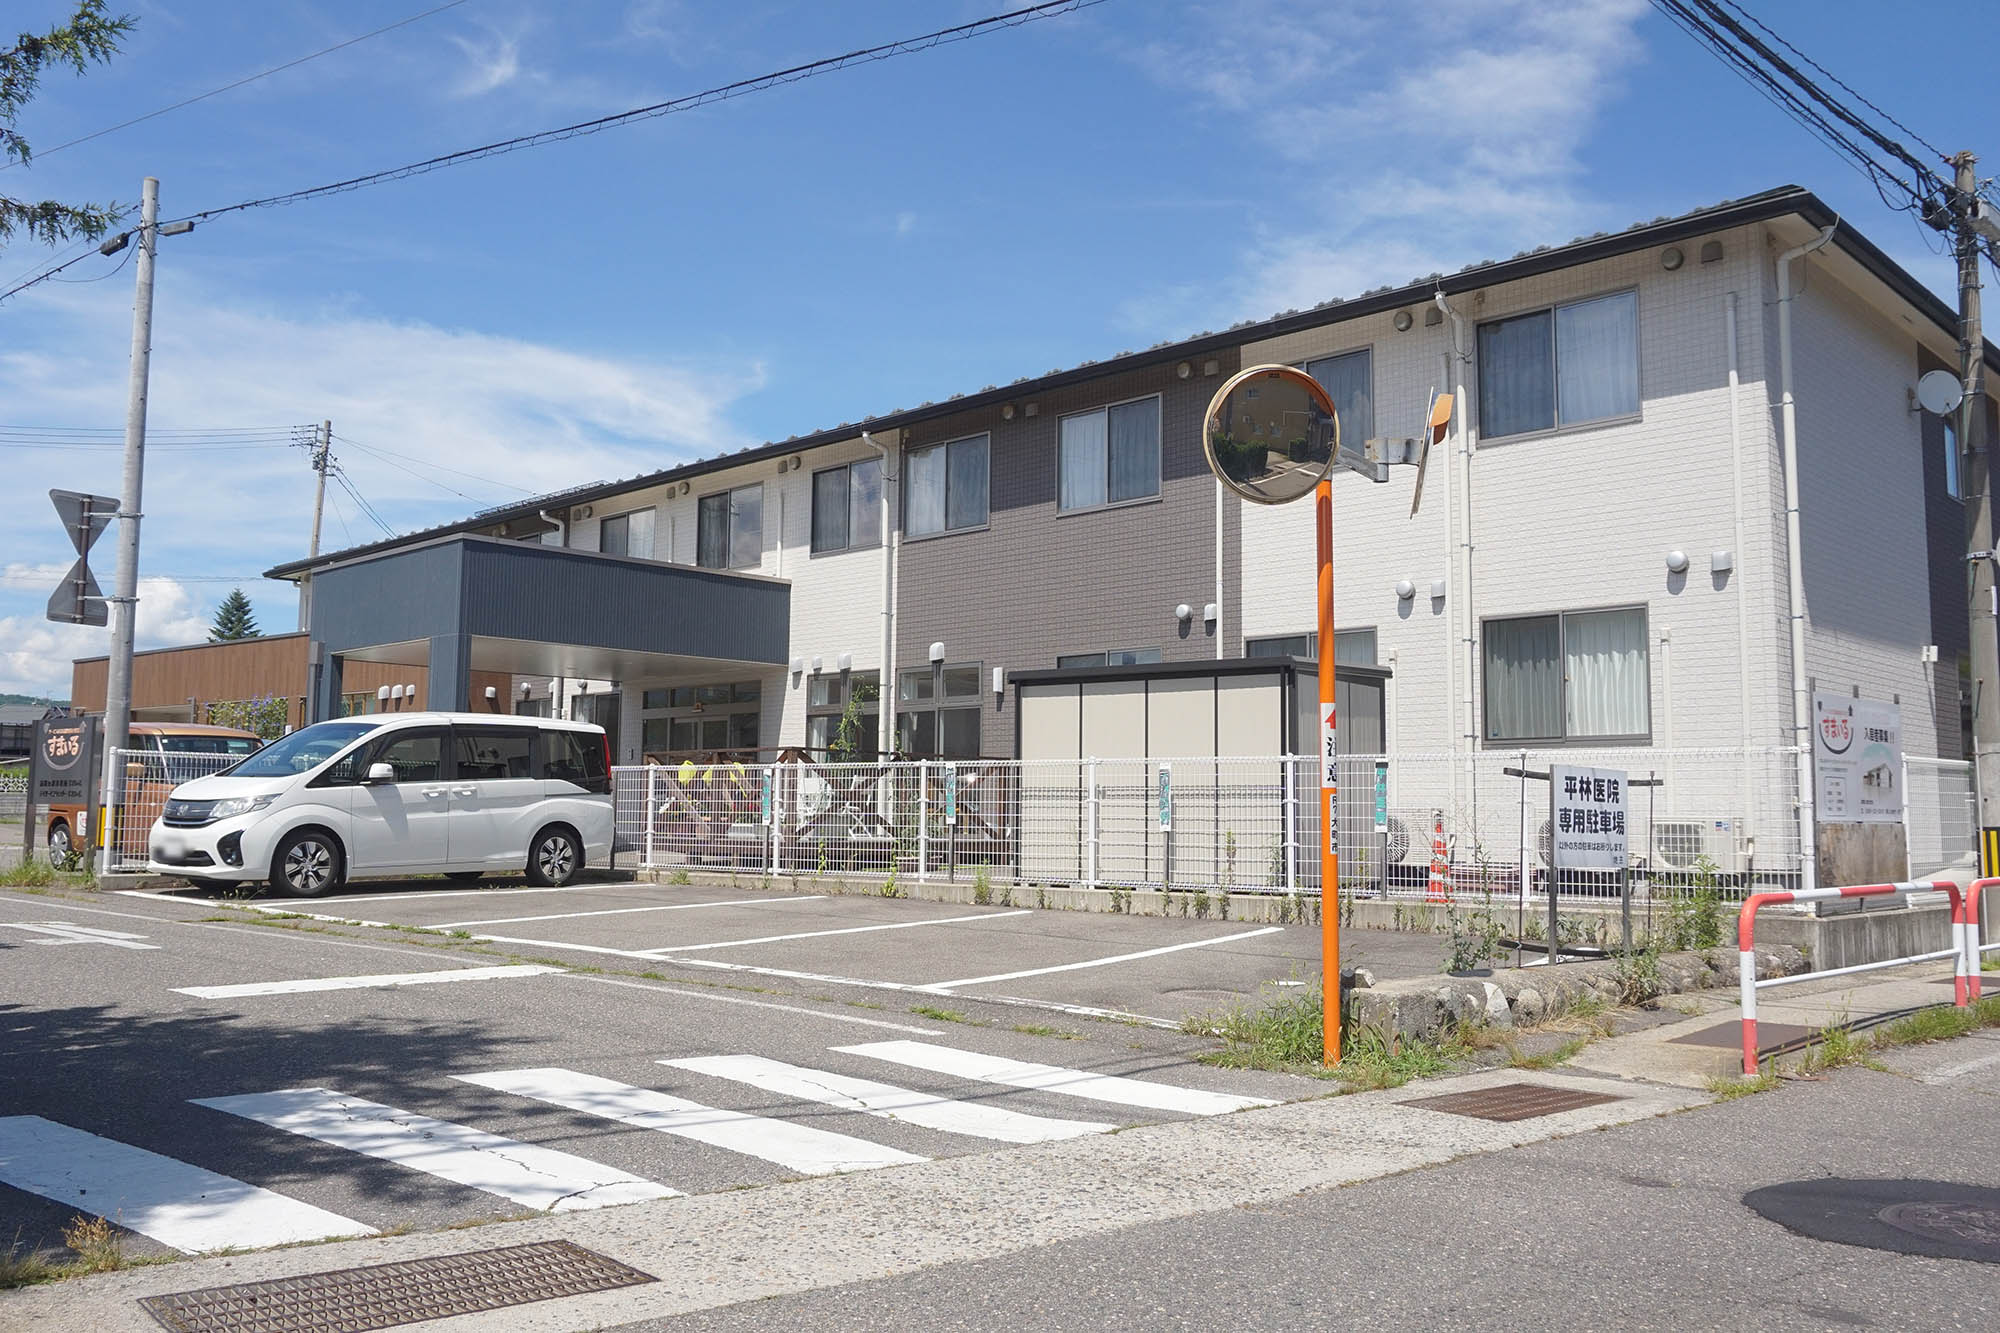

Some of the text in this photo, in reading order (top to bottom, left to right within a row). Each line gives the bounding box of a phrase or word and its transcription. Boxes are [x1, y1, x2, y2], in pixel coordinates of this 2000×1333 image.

[1822, 716, 1848, 741] すまいる
[48, 735, 79, 757] すまいる
[1564, 775, 1620, 804] 平林医院
[1559, 807, 1625, 836] 専用駐車場
